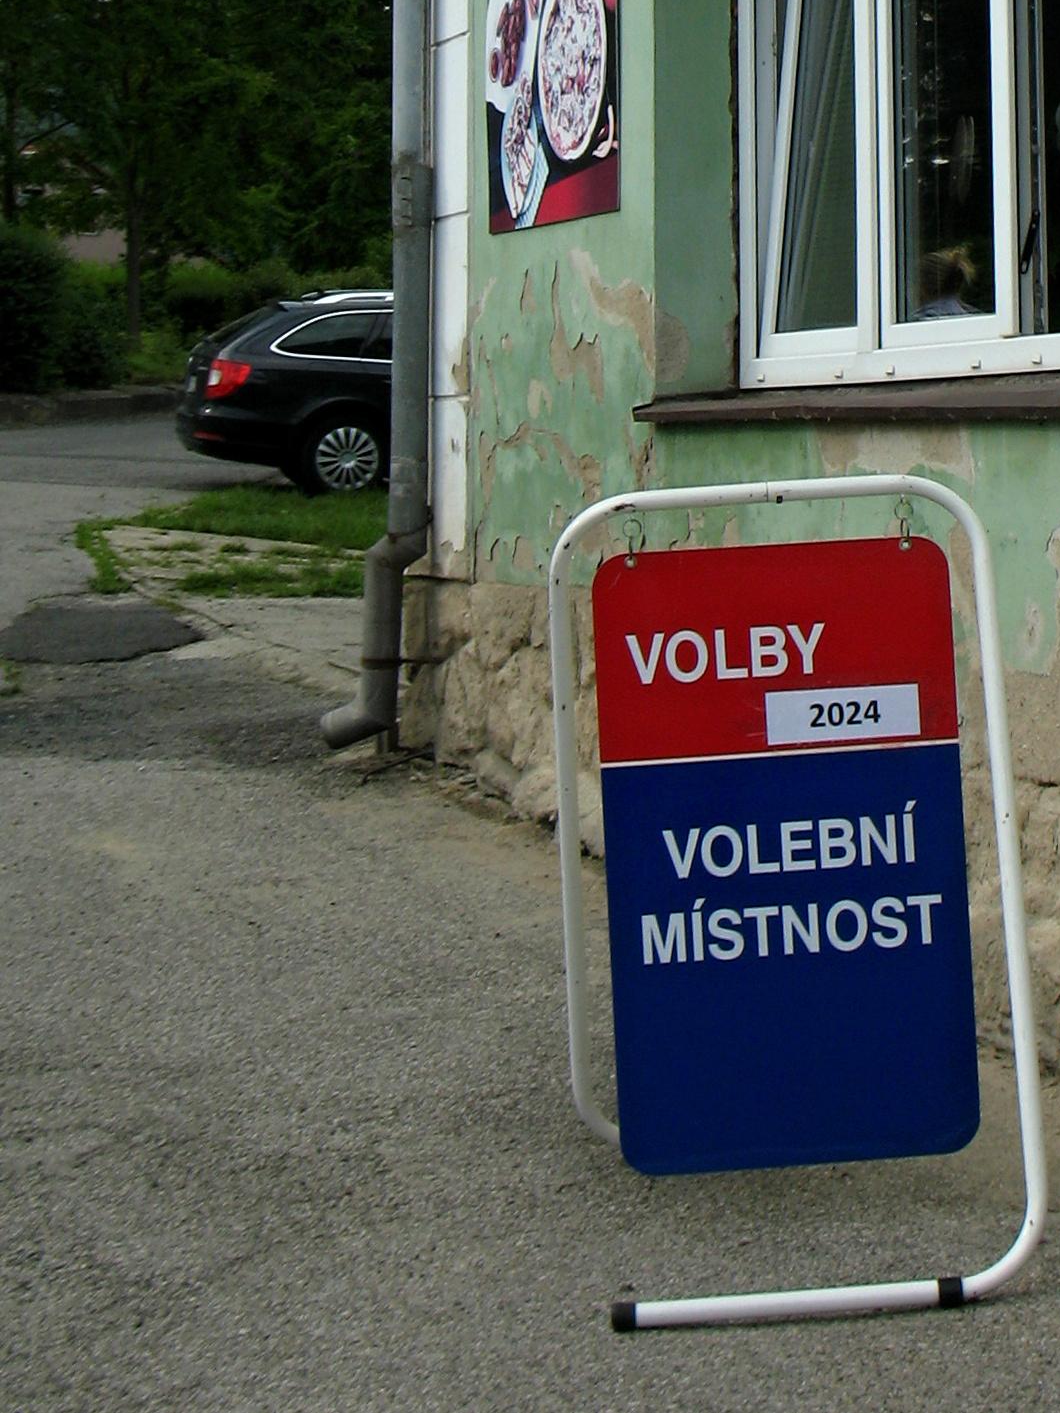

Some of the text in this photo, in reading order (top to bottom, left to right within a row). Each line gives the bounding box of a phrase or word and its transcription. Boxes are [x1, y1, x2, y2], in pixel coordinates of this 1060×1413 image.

[625, 622, 825, 685] VOLBY
[808, 700, 882, 728] 2024
[662, 800, 917, 879] VOLEBNÍ
[641, 894, 943, 965] MÍSTNOST
